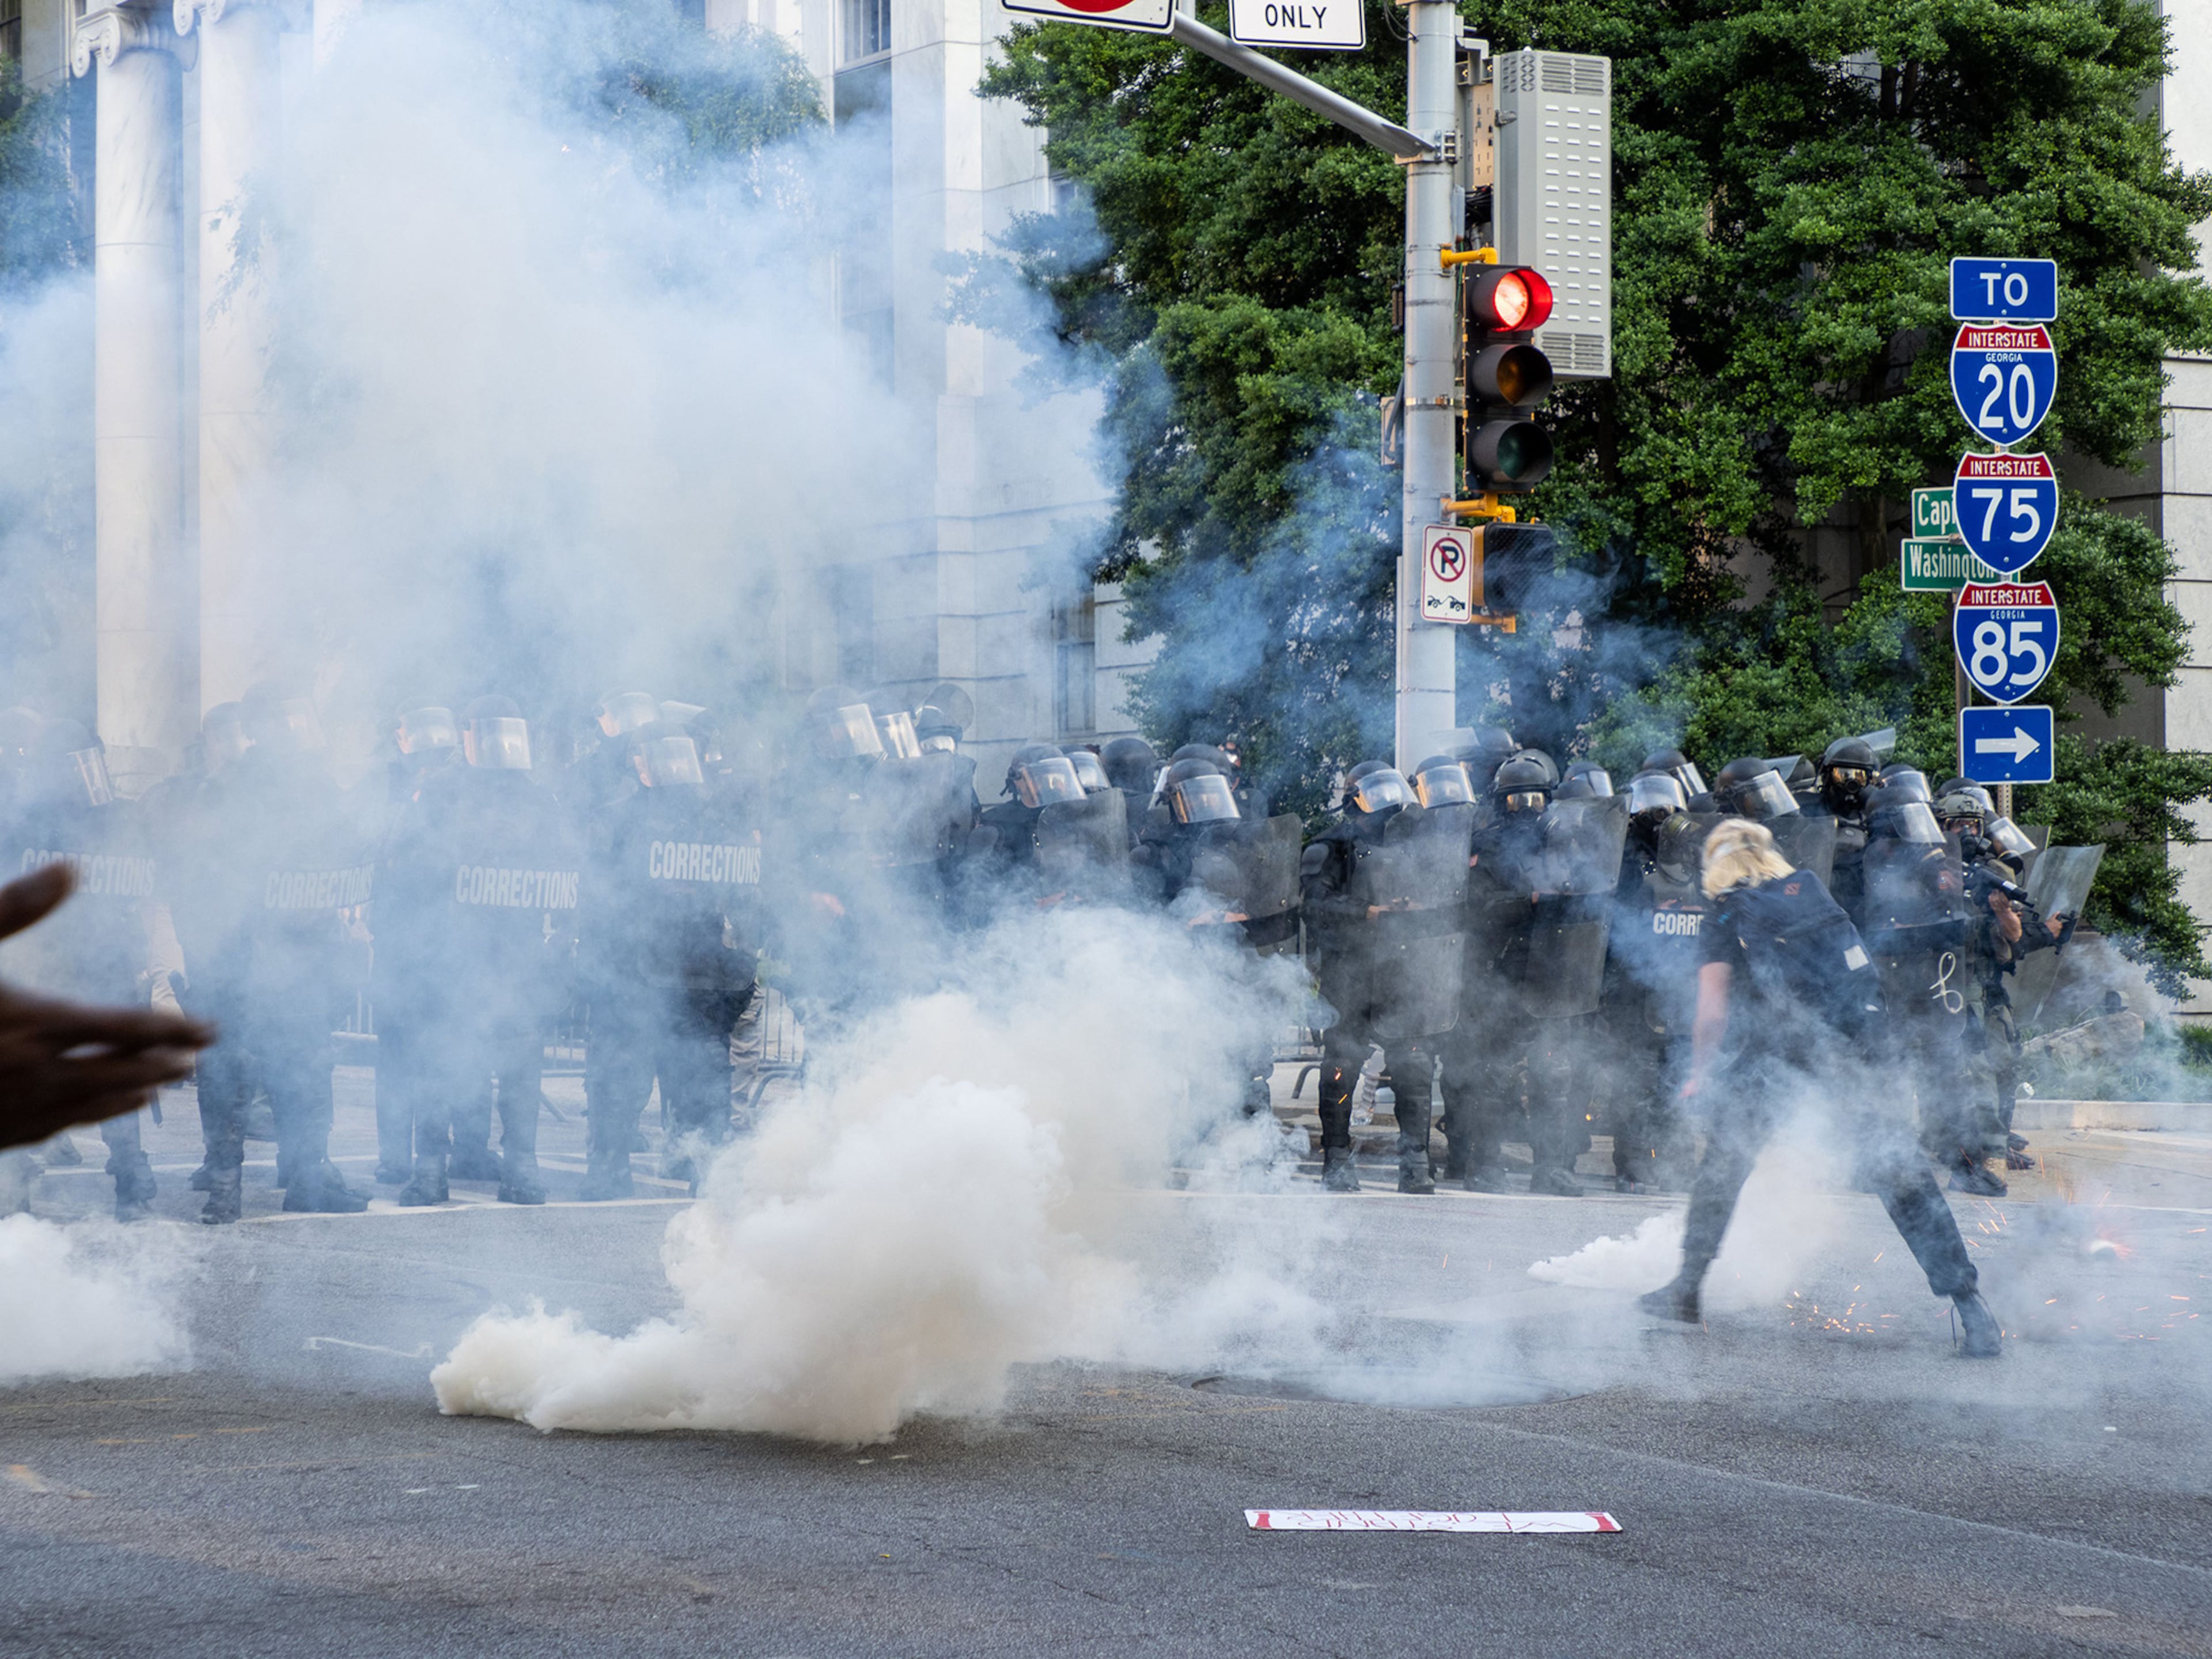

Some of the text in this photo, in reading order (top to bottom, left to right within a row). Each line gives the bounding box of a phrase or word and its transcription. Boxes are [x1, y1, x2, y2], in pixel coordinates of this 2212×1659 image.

[1266, 4, 1327, 28] ONLY
[1980, 272, 2028, 306] TO
[1968, 332, 2038, 347] INTERSTATE
[1986, 353, 2022, 362] GEORGIA
[1978, 363, 2035, 429] 20
[1970, 461, 2041, 476] INTERSTATE
[1972, 488, 2040, 543] 75
[1971, 589, 2042, 605] INTERSTATE
[1990, 609, 2025, 619] GEORGIA
[1971, 621, 2046, 686] 85
[649, 840, 761, 885] CORRECTIONS
[264, 863, 375, 908] CORRECTIONS
[456, 865, 579, 909] CORRECTIONS
